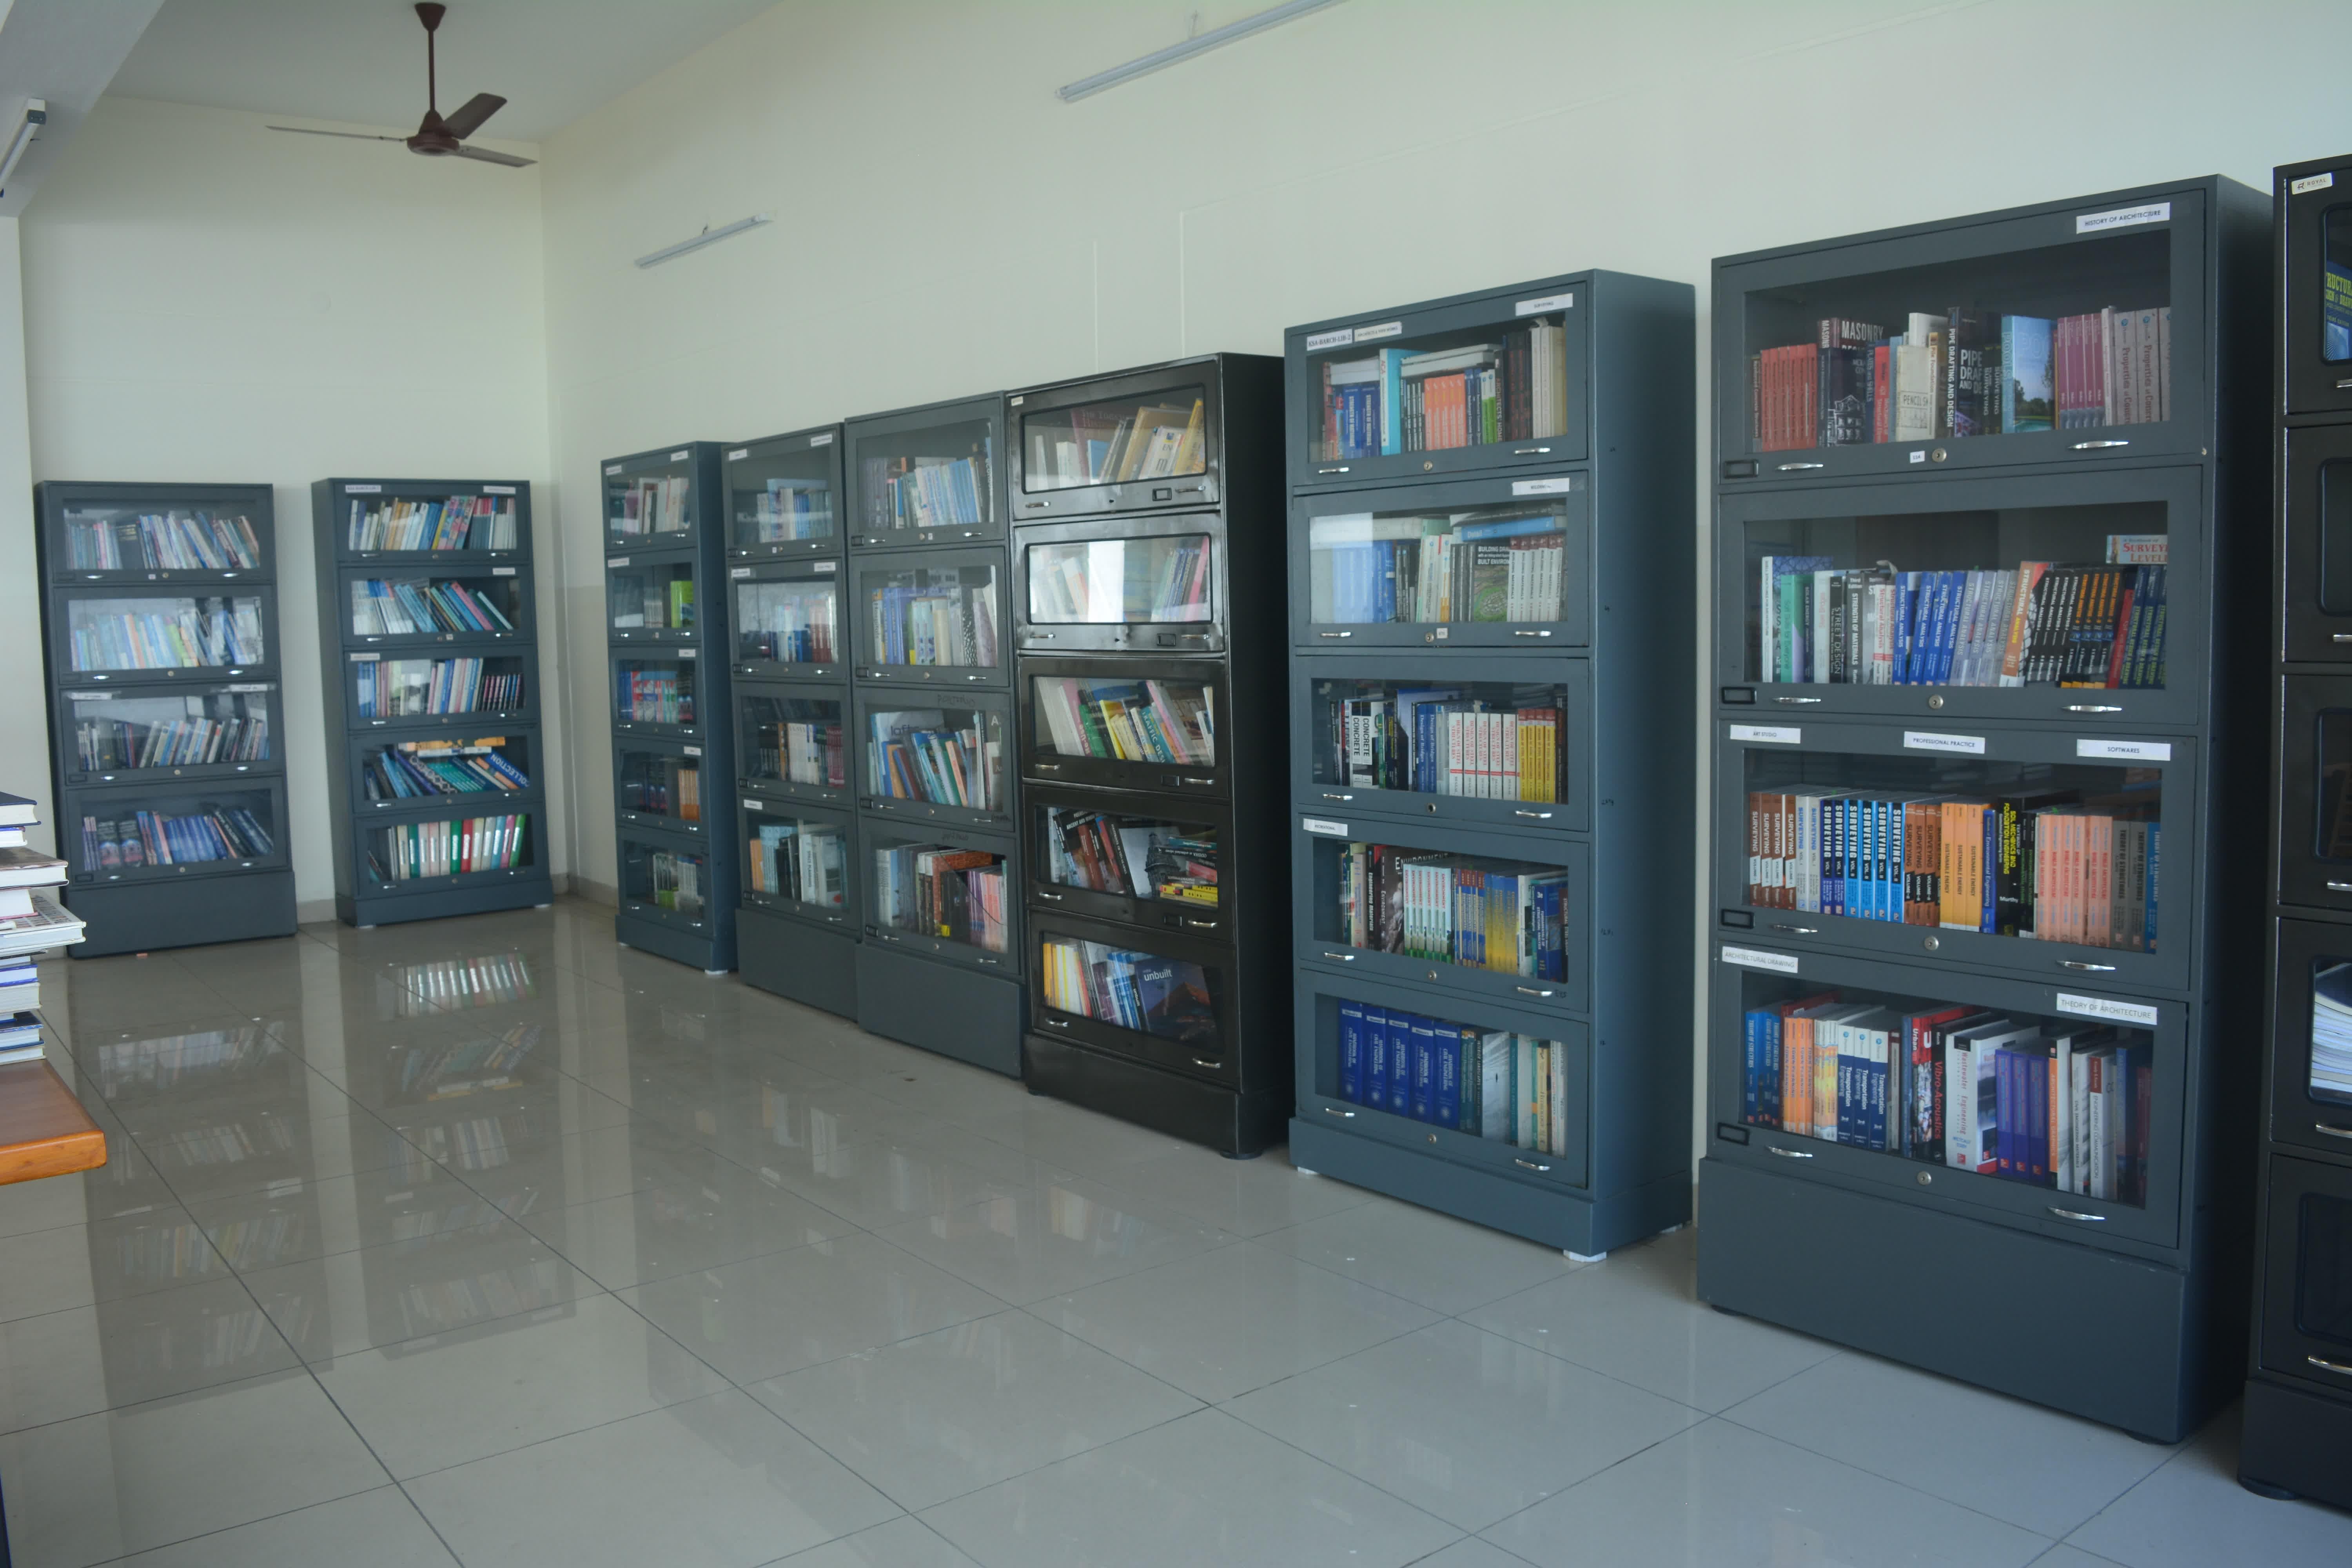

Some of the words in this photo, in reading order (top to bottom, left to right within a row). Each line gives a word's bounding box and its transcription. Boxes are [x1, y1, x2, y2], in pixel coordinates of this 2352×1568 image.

[2119, 210, 2160, 221] ARCHITECTURE
[2122, 347, 2130, 388] Properties
[2143, 345, 2152, 387] Properties
[1922, 585, 1931, 621] STRUCTURAL
[1938, 584, 1948, 621] STRUCTURAL
[1952, 586, 1962, 622] STRUCTURAL
[2017, 569, 2030, 615] STRUCTURAL
[1948, 623, 1956, 649] ANALYSIS
[1893, 809, 1901, 862] SURVEYING
[1144, 969, 1172, 981] unbuilt
[1725, 951, 1766, 964] ARCHITECTURAL
[2062, 999, 2087, 1009] THEORY
[2100, 1005, 2151, 1019] ARCHITECTURE
[1935, 1061, 1944, 1140] Vibro-Acoustics
